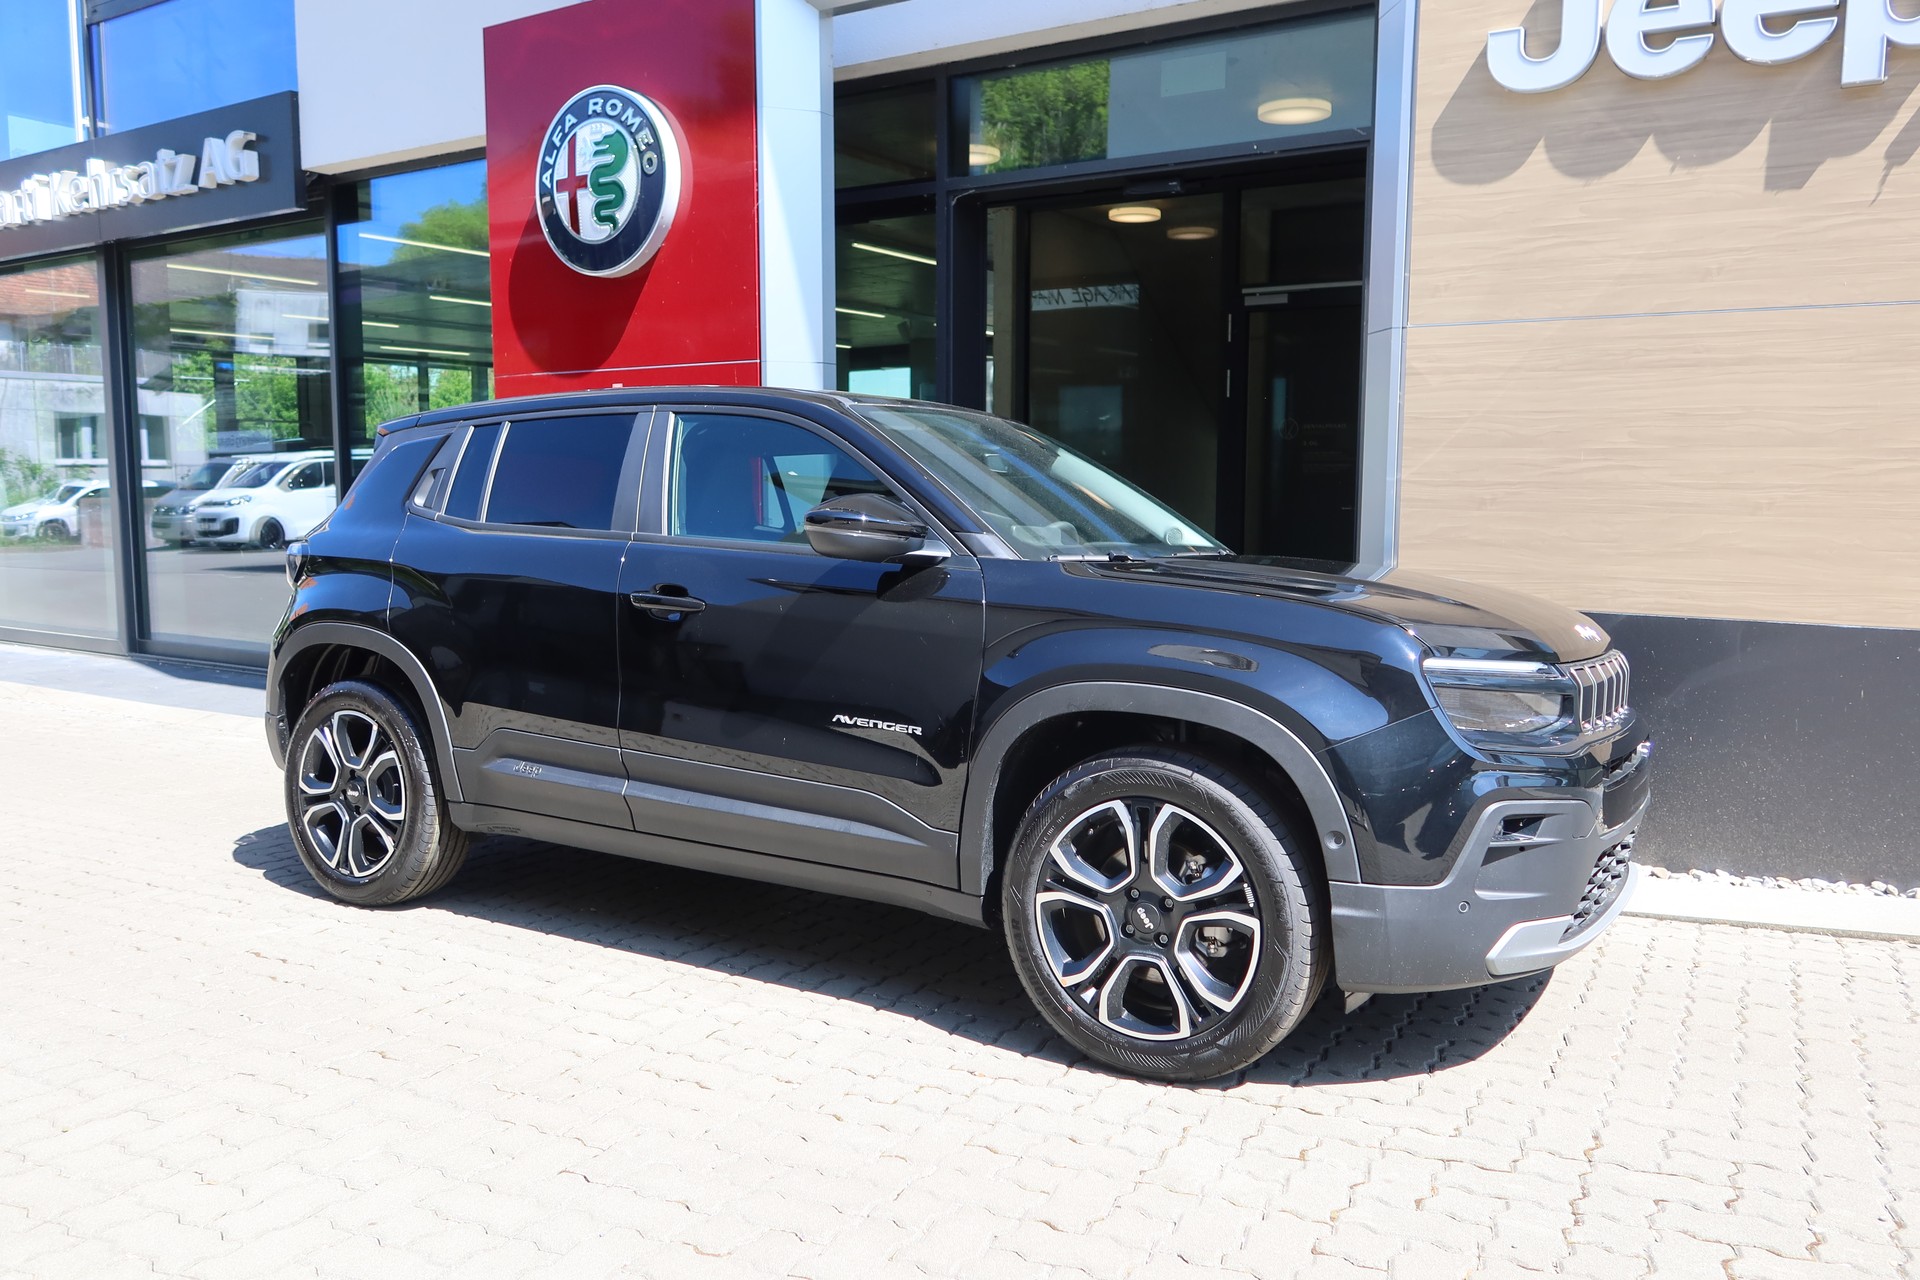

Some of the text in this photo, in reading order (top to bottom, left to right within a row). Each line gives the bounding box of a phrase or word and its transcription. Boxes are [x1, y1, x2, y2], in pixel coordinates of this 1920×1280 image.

[1487, 0, 1920, 94] Jeep
[198, 129, 260, 189] AG
[542, 97, 658, 189] ALFA ROMEO
[832, 714, 922, 736] AVENGER
[1136, 907, 1154, 930] Jeep
